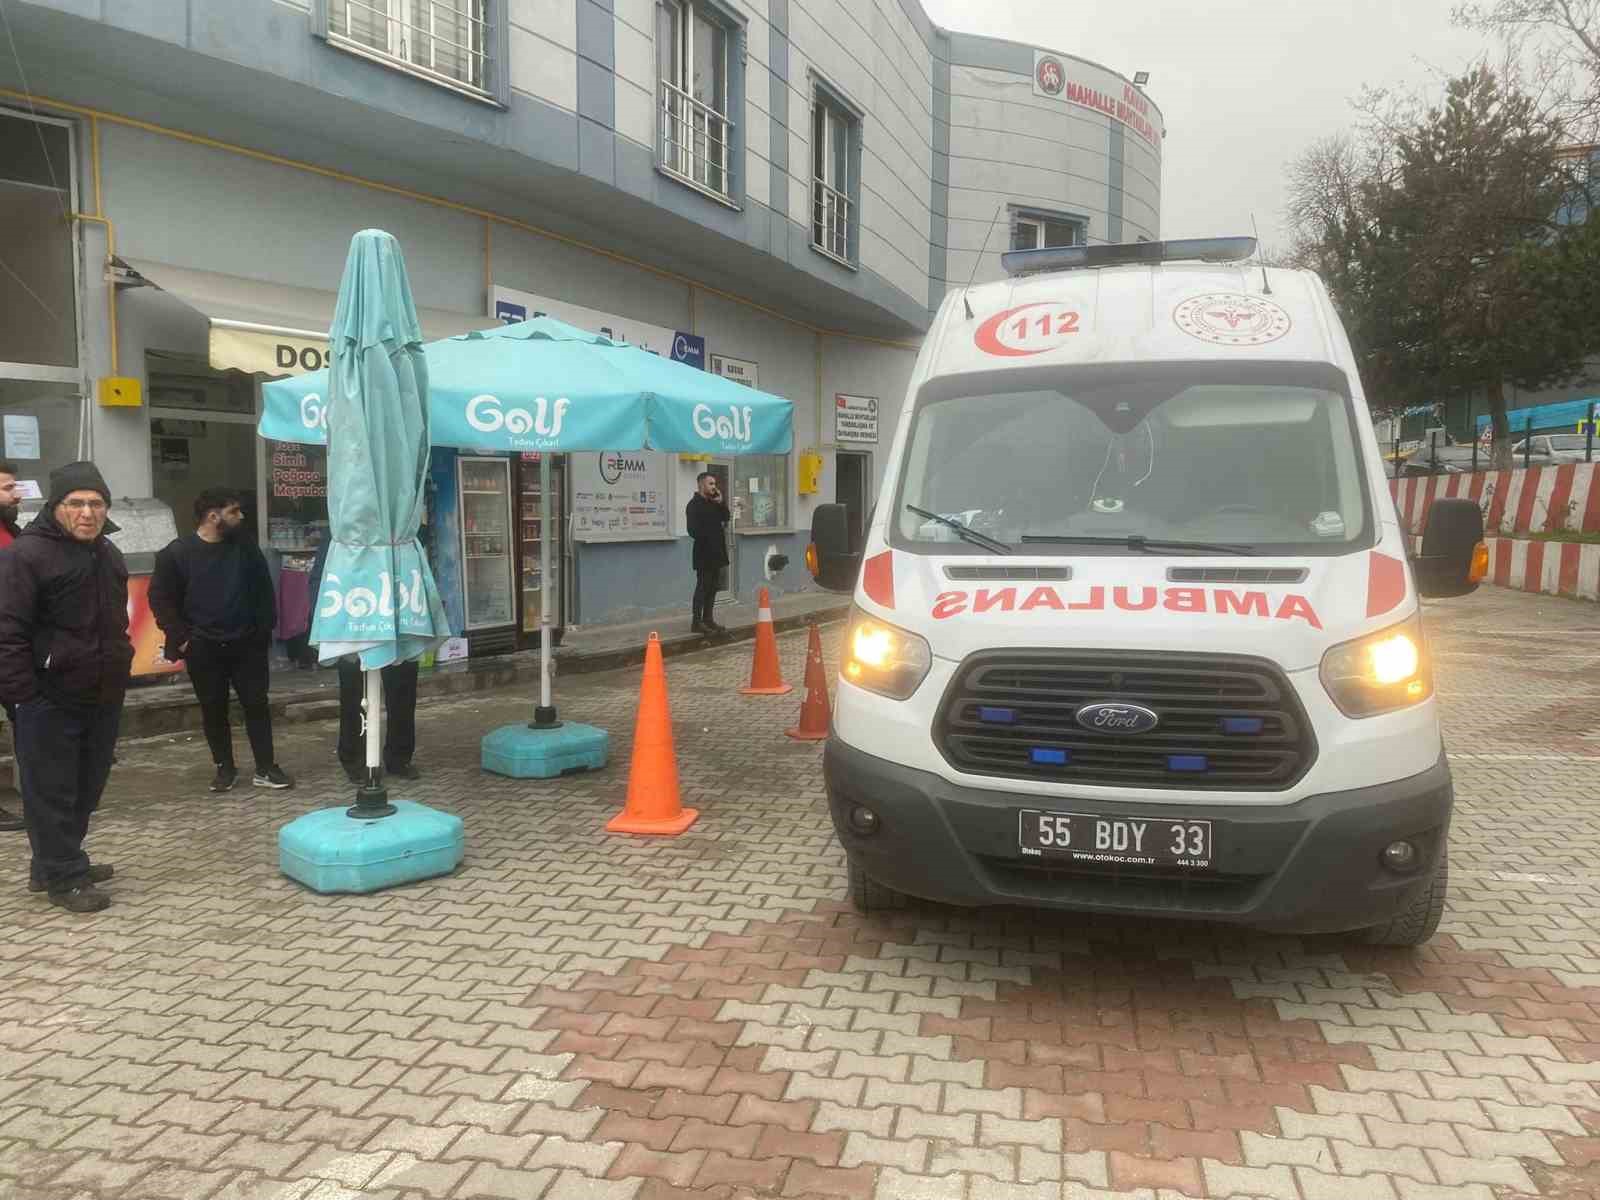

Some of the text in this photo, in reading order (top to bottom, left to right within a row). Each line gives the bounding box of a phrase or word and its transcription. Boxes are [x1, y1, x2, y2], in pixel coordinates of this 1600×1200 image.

[1011, 310, 1080, 340] 112
[465, 394, 571, 435] Golf
[692, 403, 753, 441] Golf
[272, 453, 305, 466] Simit
[607, 458, 645, 472] REMM
[273, 482, 328, 498] Meşruba
[1094, 706, 1138, 730] Ford
[1039, 816, 1204, 855] 55 BDY 33
